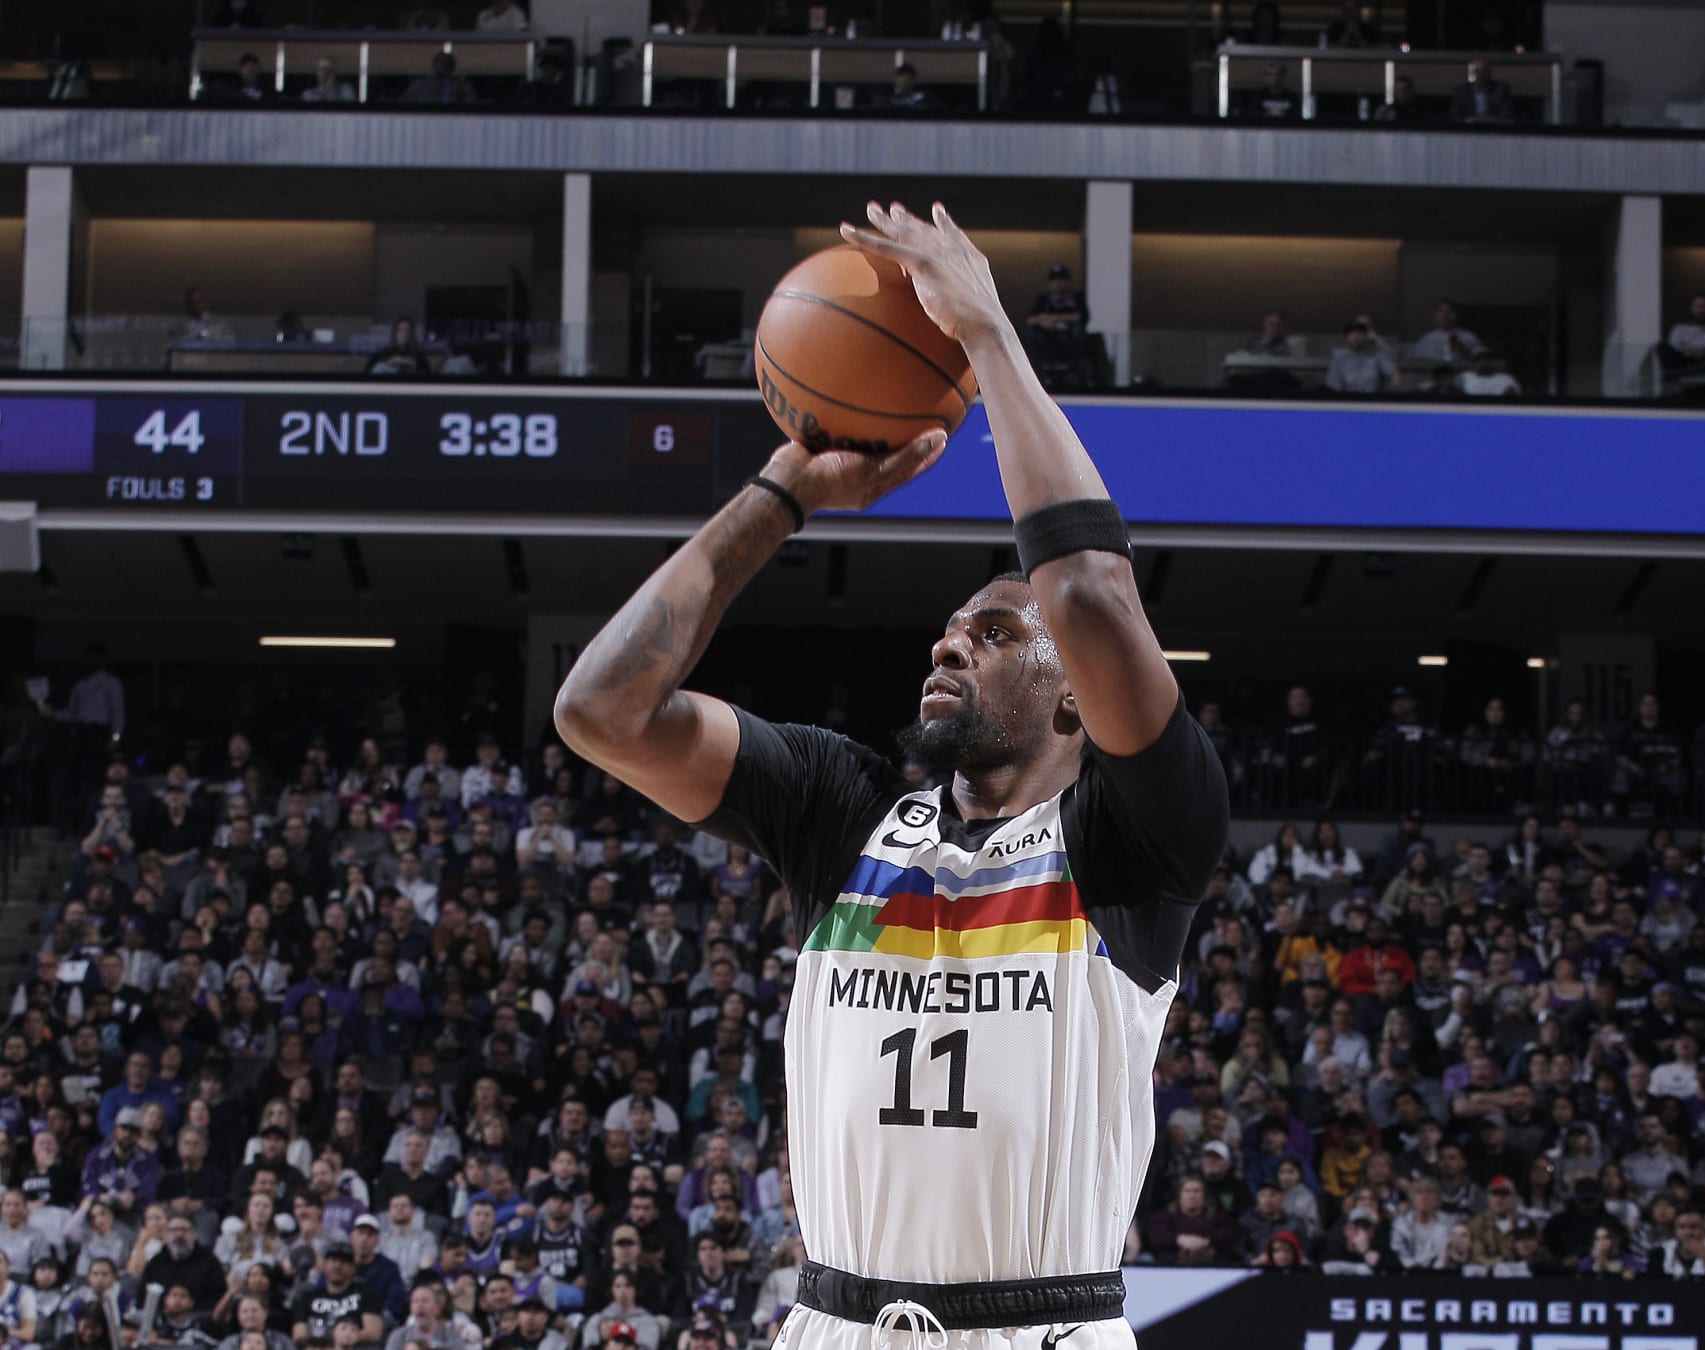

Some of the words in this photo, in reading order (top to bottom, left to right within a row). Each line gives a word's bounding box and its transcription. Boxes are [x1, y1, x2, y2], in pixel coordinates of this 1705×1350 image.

[134, 409, 205, 453] 44
[279, 411, 388, 455] 2ND
[440, 413, 557, 457] 3:38
[653, 425, 674, 453] 6
[106, 476, 186, 500] FOULS
[196, 477, 214, 500] 3
[904, 805, 932, 825] 6
[829, 967, 1054, 1014] MINNESOTA
[878, 1027, 979, 1129] 11
[1330, 1298, 1675, 1326] SACRAMENTO
